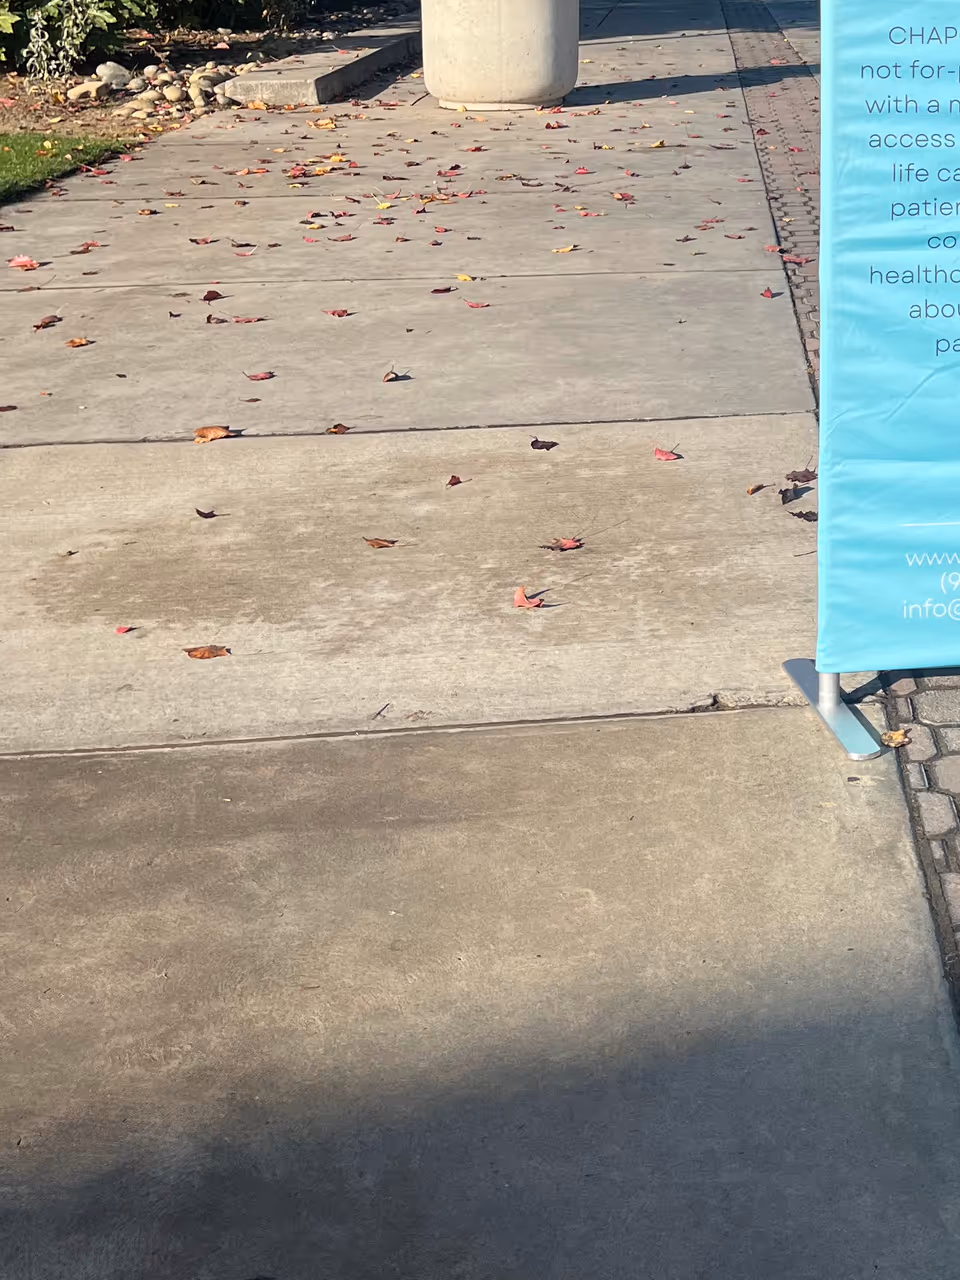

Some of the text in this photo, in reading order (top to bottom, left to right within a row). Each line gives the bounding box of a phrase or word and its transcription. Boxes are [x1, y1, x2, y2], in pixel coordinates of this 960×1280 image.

[860, 63, 902, 80] not
[865, 94, 918, 114] with
[927, 99, 940, 114] a
[868, 132, 955, 149] access
[892, 164, 929, 183] life
